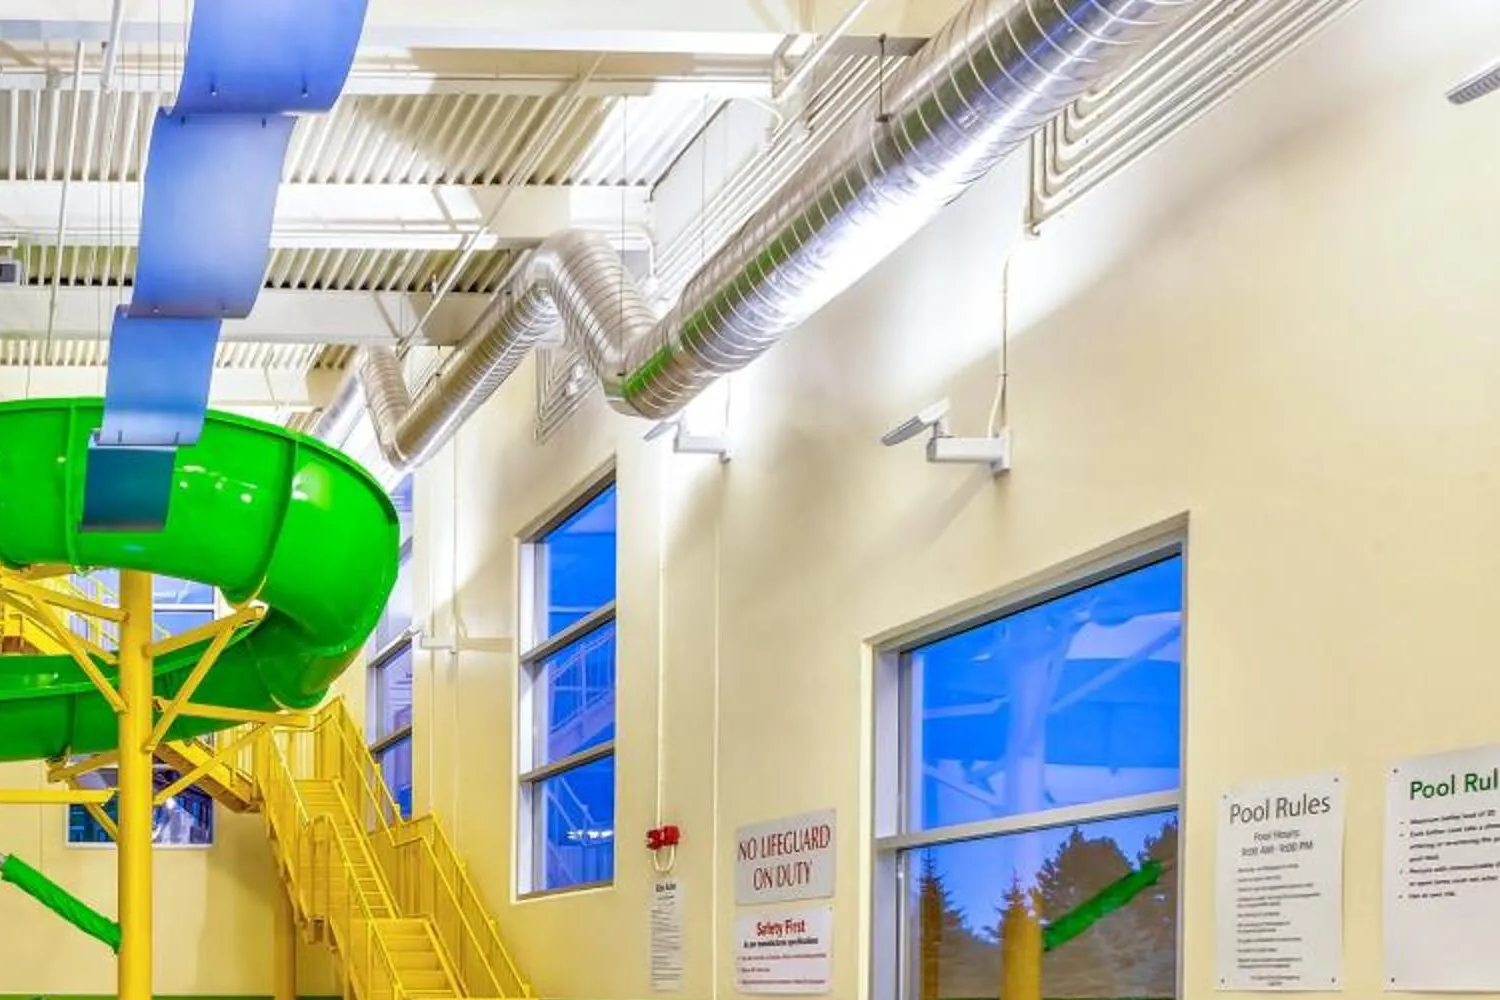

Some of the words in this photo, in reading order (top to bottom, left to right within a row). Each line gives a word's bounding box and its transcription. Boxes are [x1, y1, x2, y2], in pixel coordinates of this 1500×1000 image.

[1410, 774, 1455, 800] Pool
[1464, 767, 1500, 793] Rul
[1229, 798, 1270, 825] Pool
[1275, 793, 1331, 819] Rules
[737, 837, 758, 862] NO
[760, 824, 831, 859] LIFEGUARD
[753, 866, 773, 891] ON
[776, 860, 813, 887] DUTY
[756, 920, 782, 938] Safety
[785, 918, 806, 934] First
